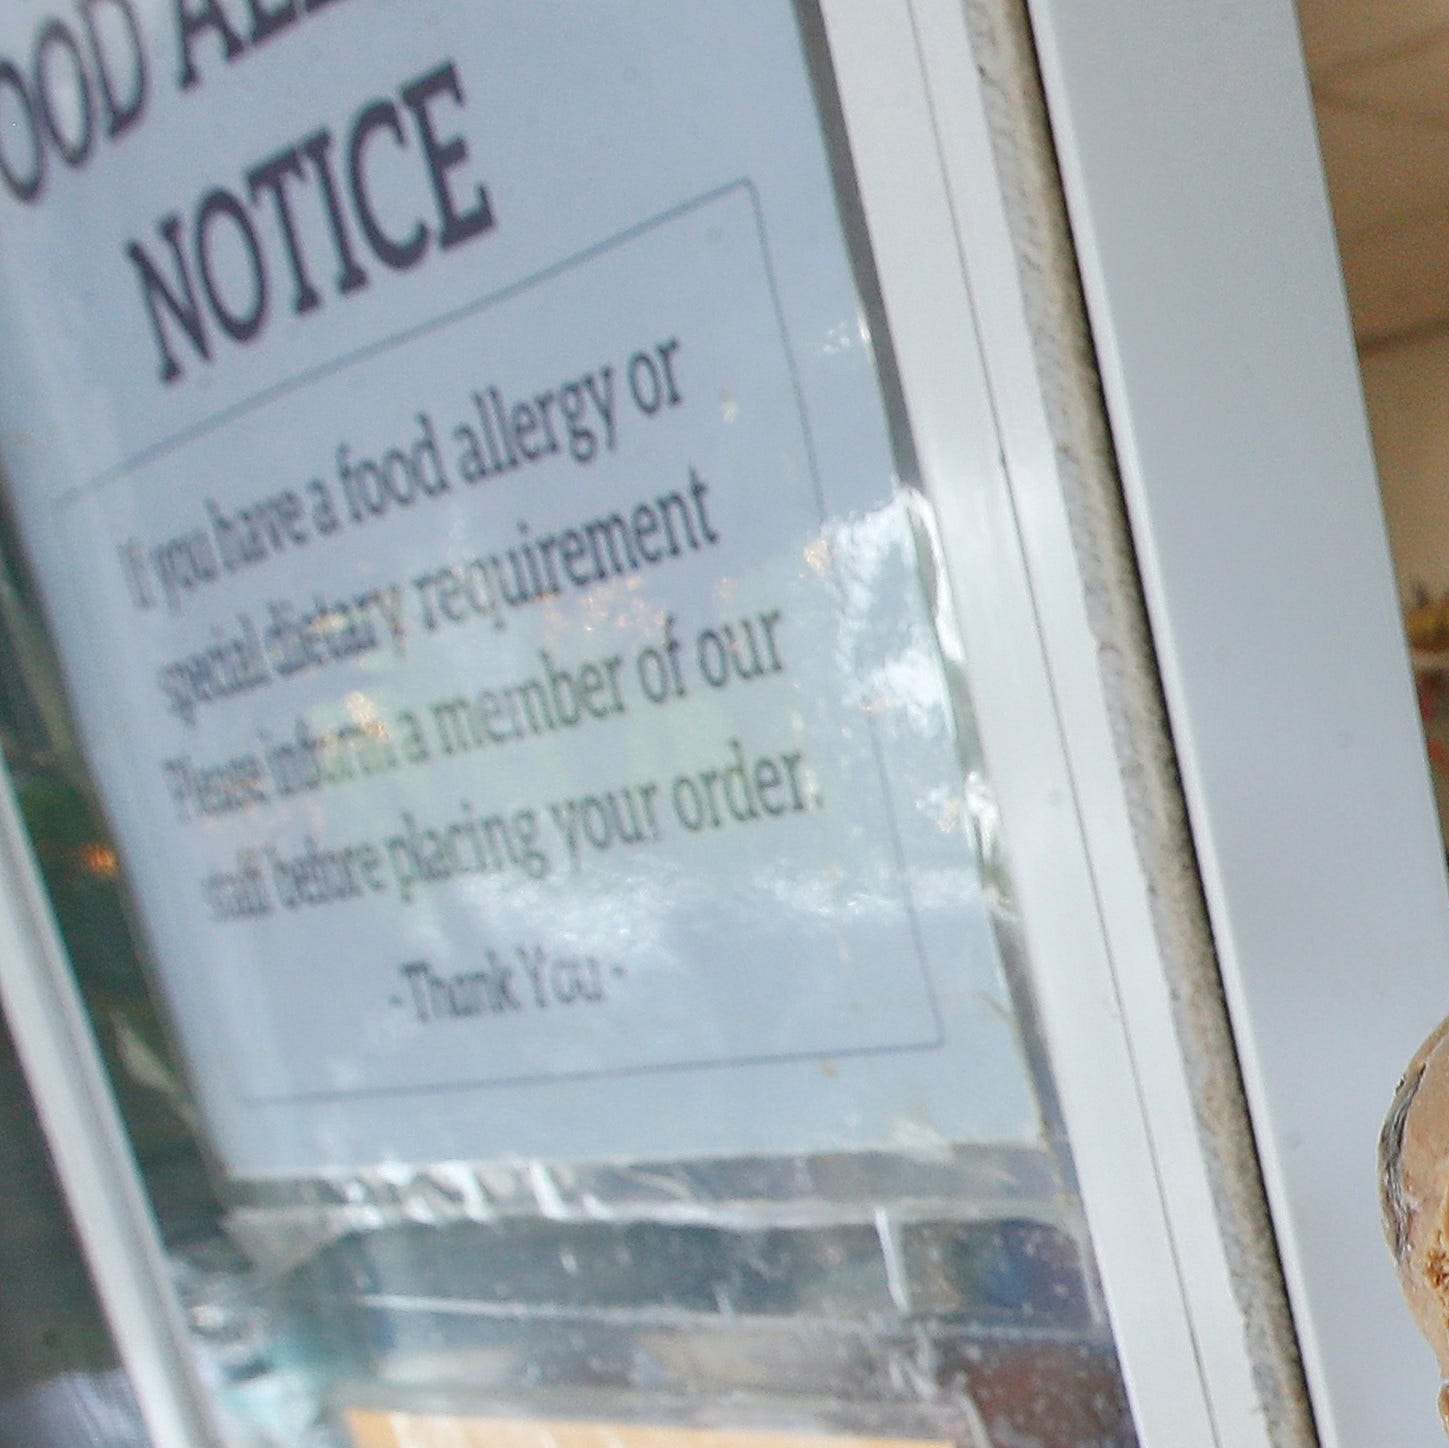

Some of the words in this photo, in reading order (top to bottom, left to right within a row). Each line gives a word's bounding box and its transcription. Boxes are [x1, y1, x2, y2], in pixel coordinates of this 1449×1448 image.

[125, 56, 497, 386] NOTICE
[203, 488, 306, 575] have
[304, 476, 342, 537] a
[336, 410, 451, 525] food
[452, 383, 618, 464] allergy
[627, 337, 683, 419] or
[413, 463, 722, 632] requirement
[396, 709, 430, 764] a
[430, 646, 628, 756] member
[635, 612, 689, 705] of
[696, 607, 783, 689] our
[385, 800, 551, 901] placing
[545, 780, 670, 876] your
[514, 942, 608, 1009] You
